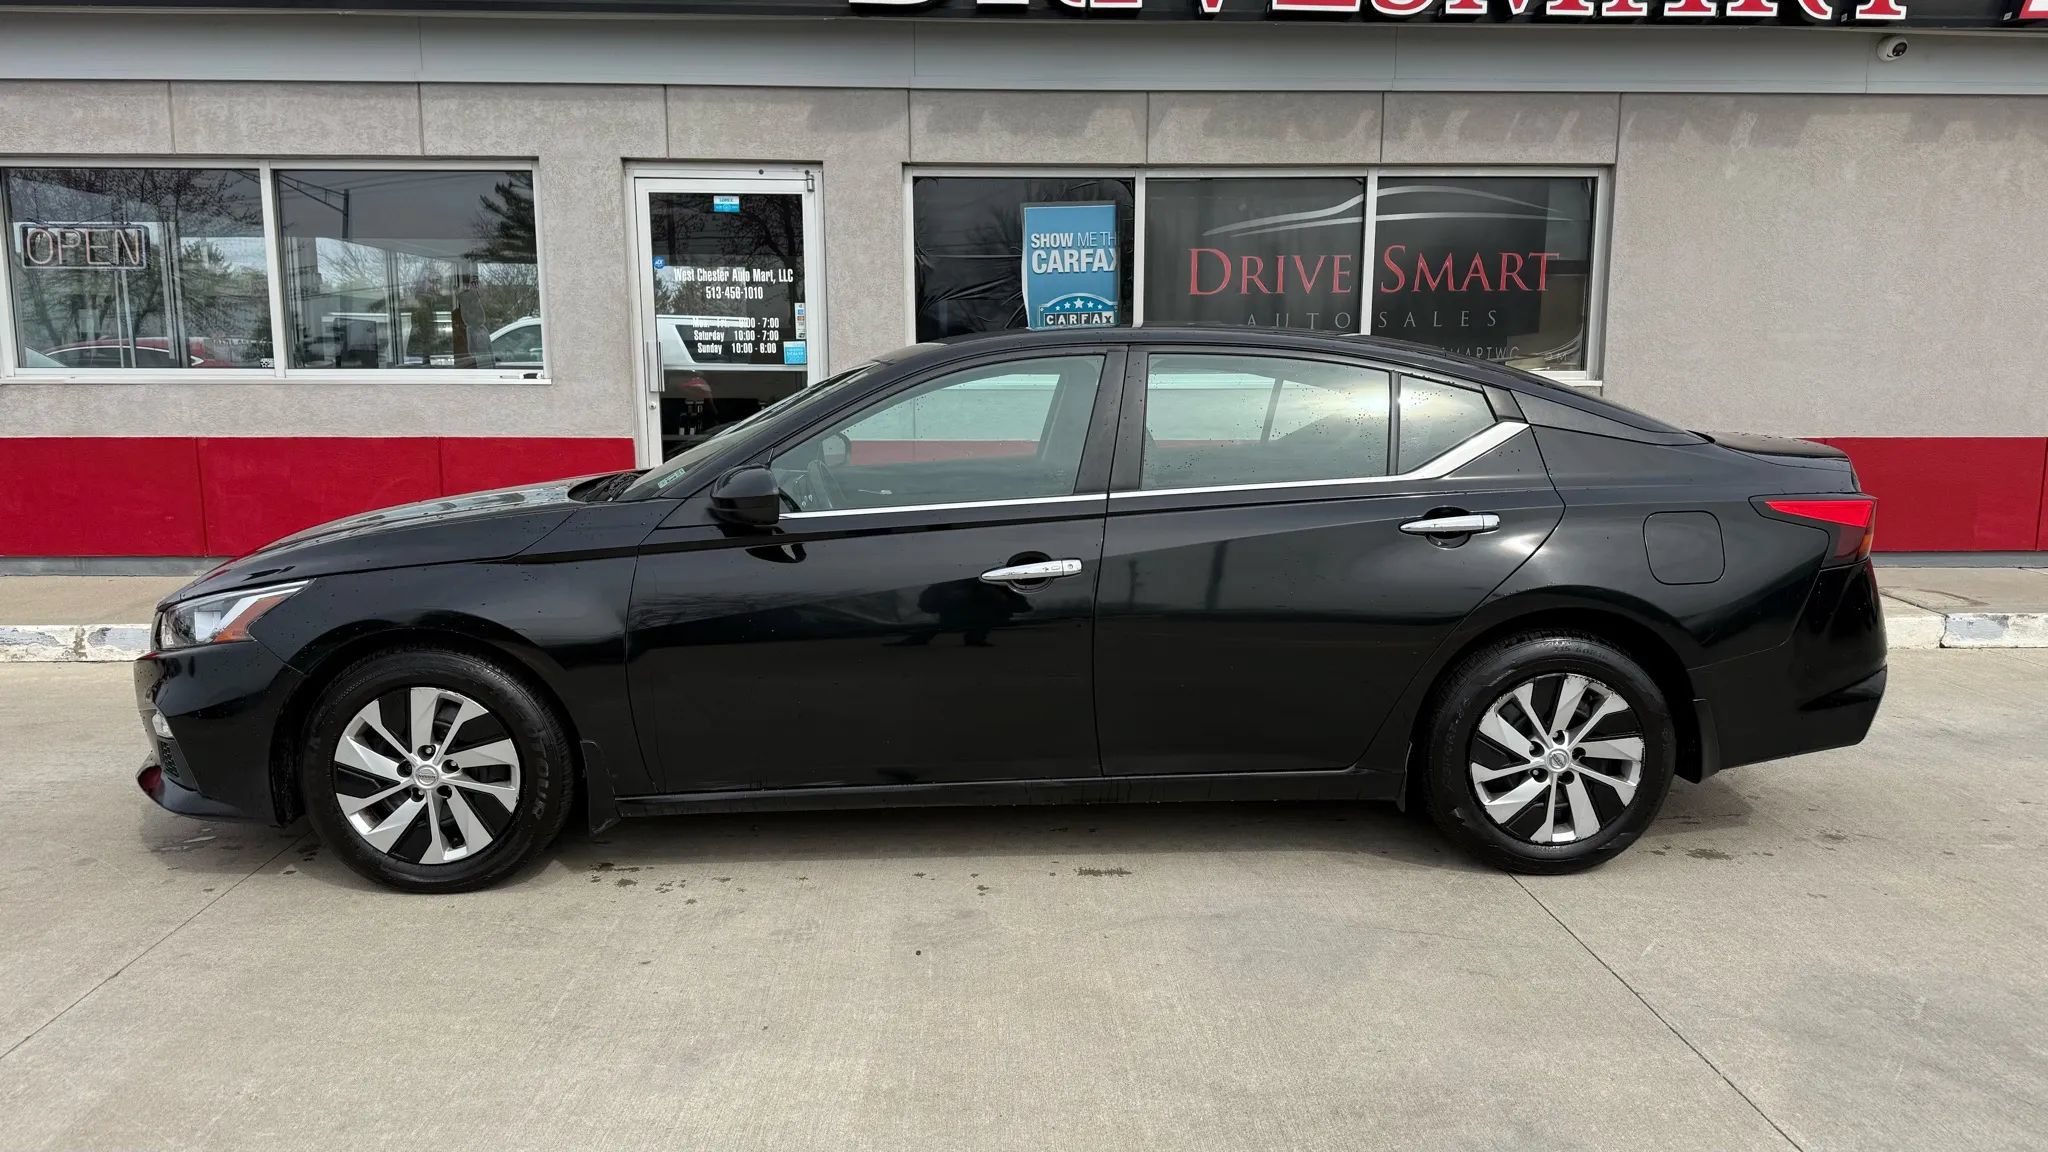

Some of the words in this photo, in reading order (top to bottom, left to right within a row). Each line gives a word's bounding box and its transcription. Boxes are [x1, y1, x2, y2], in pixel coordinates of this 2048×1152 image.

[27, 228, 139, 265] OPEN
[1031, 233, 1074, 248] SHOW
[1077, 232, 1098, 247] ME
[674, 268, 695, 282] West
[697, 268, 729, 282] Chester
[732, 268, 750, 282] Auto
[753, 268, 776, 285] Mart,
[779, 268, 794, 282] LLC
[1188, 248, 1353, 296] DRIVE
[1380, 244, 1560, 293] SMART
[762, 317, 780, 329] 7:00
[1046, 314, 1114, 325] CARFAX
[1247, 312, 1352, 329] AUTO
[1378, 310, 1497, 328] SALES
[694, 330, 725, 342] Saturday
[734, 330, 755, 341] 10:00
[762, 330, 779, 341] 7:00
[698, 343, 723, 355] Sunday
[732, 343, 753, 354] 10:00
